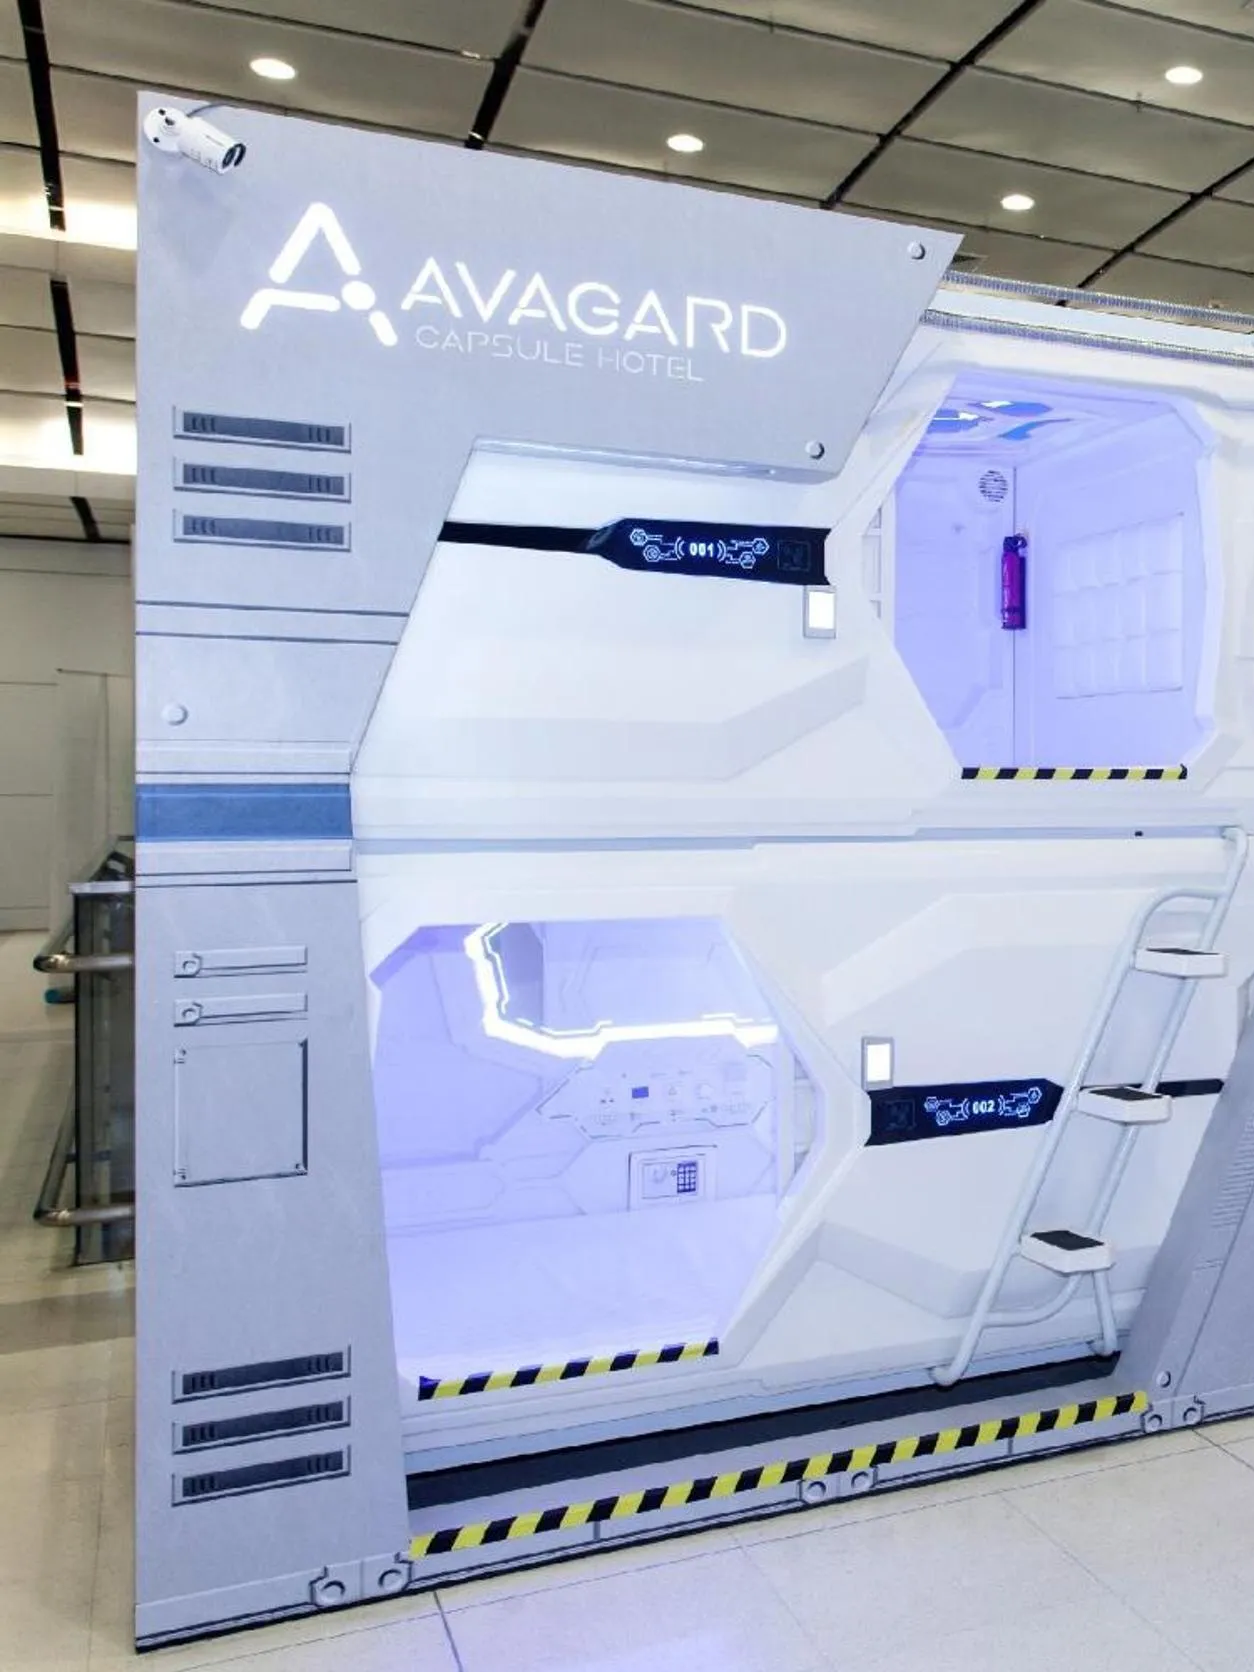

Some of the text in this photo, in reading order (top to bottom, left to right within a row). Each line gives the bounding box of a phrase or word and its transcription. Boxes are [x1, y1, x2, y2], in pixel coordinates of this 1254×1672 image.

[400, 256, 787, 358] AVAGARD
[415, 325, 704, 382] CAPSULE HOTEL
[690, 542, 713, 557] 001
[973, 1100, 995, 1114] 002
